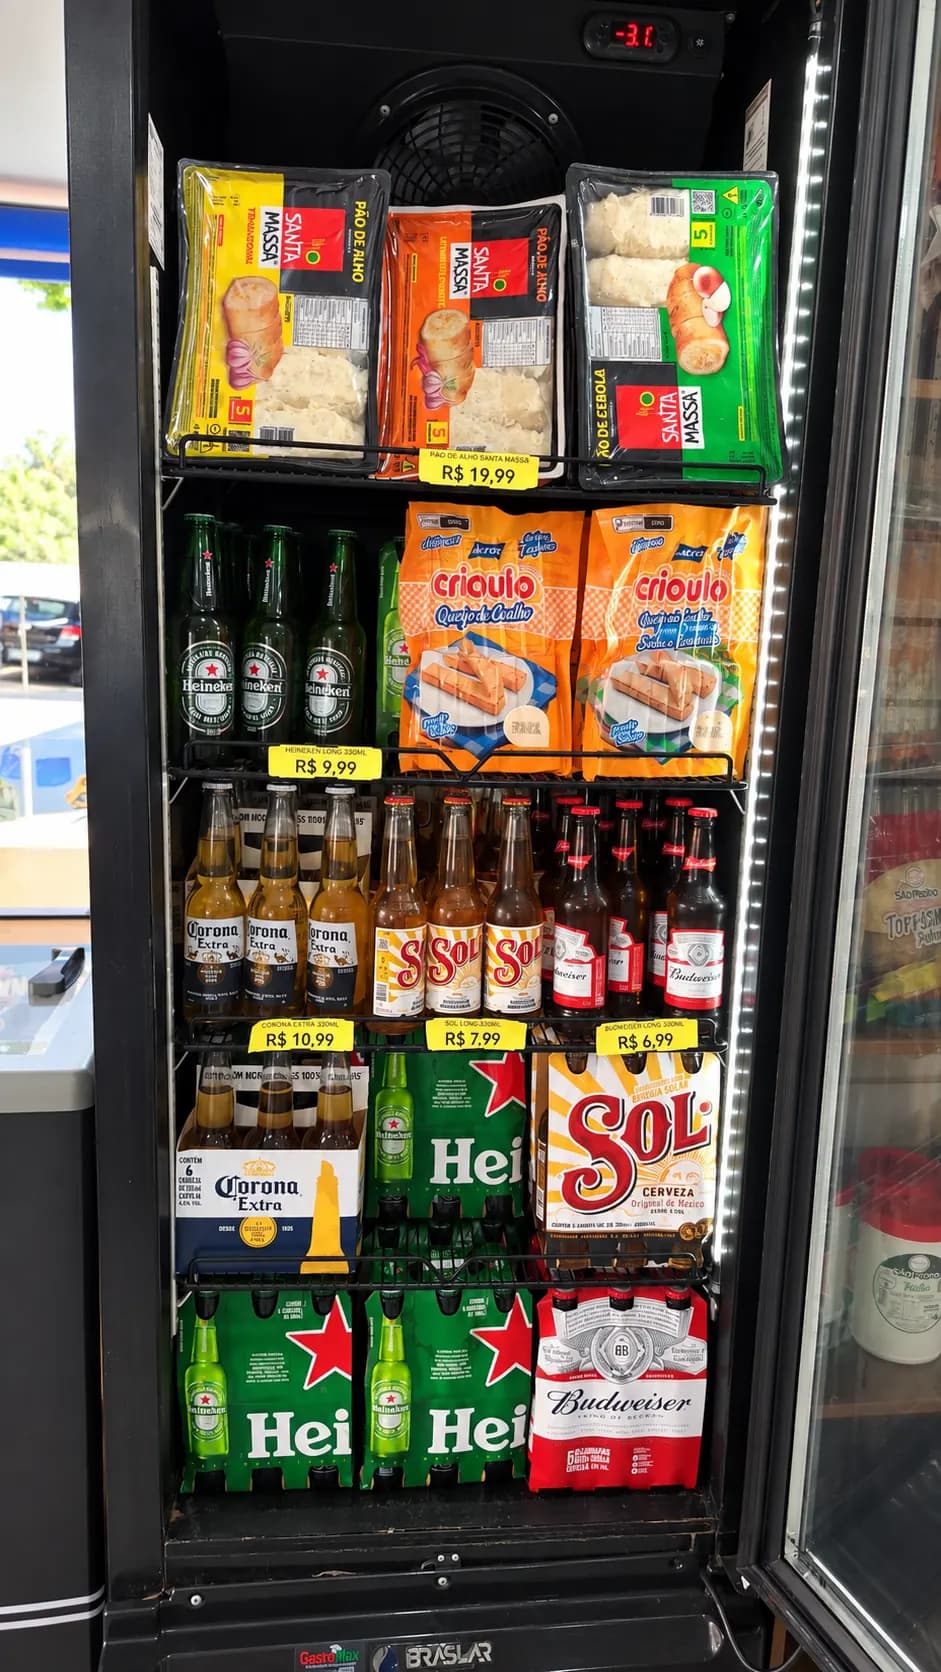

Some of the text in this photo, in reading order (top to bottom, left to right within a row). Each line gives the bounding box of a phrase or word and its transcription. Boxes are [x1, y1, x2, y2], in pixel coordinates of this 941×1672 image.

[261, 211, 280, 262] MASSA
[283, 212, 304, 264] SANTA
[352, 200, 369, 283] PÃO DE ALHO
[694, 228, 708, 240] 5
[453, 247, 469, 294] MASSA
[472, 246, 490, 293] SANTA
[536, 255, 548, 268] DE
[597, 418, 610, 437] DE
[659, 392, 680, 443] SANTA
[684, 391, 699, 444] MASSA
[447, 451, 458, 460] DE
[459, 452, 479, 461] ALHO
[479, 454, 503, 463] SANTA
[441, 464, 516, 486] R$ 19,99
[321, 747, 341, 756] LONG
[295, 758, 357, 776] R$ 9,99
[187, 920, 239, 941] Corona
[197, 938, 229, 949] Extra
[266, 1032, 335, 1048] R$ 10,99
[445, 1031, 501, 1047] R$ 7,99
[618, 1033, 674, 1050] R$ 6,99
[185, 1165, 193, 1176] 6
[430, 1136, 523, 1185] Hei
[215, 1175, 300, 1201] Corona
[642, 1187, 694, 1198] CERVEZA
[238, 1197, 282, 1212] Extra
[547, 1389, 692, 1416] Budweiser
[246, 1408, 352, 1459] Hei
[427, 1404, 527, 1454] Hei
[406, 1641, 493, 1669] BRASLAR
